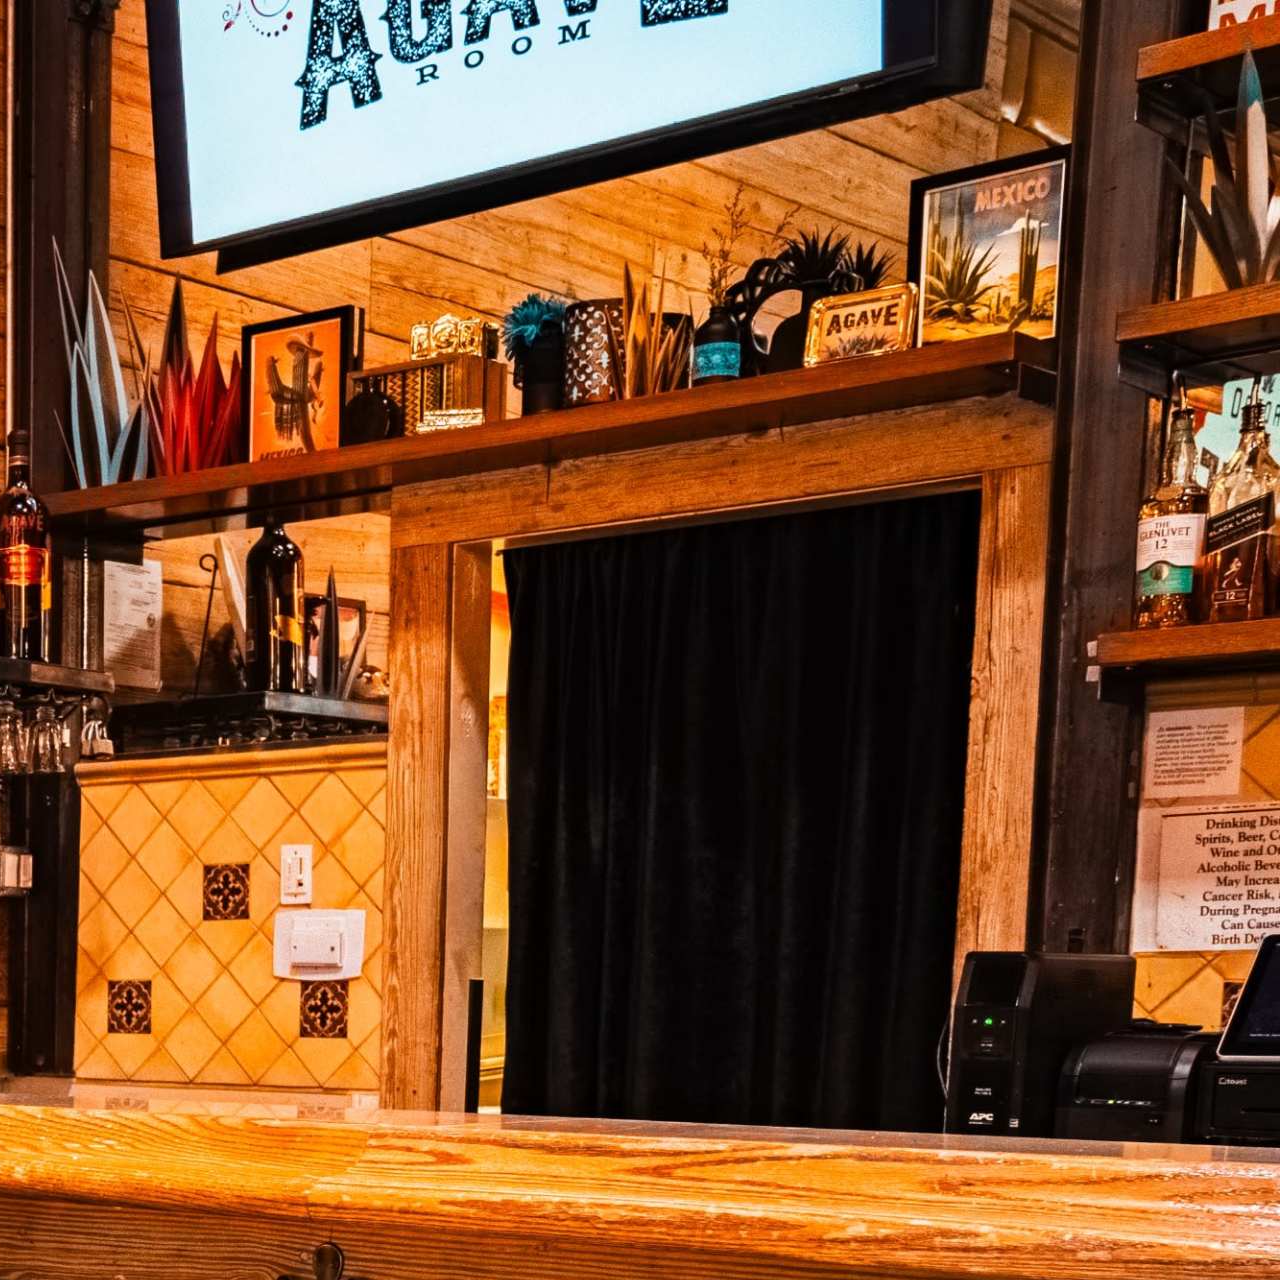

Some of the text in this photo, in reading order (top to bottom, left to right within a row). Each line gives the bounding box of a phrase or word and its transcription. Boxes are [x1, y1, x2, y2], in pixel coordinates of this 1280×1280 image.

[415, 19, 591, 86] ROOM
[974, 176, 1051, 213] MEXICO
[826, 302, 899, 336] AGAVE
[1155, 521, 1169, 529] THE
[1140, 526, 1191, 542] GLENLIVET
[1155, 538, 1168, 550] 12
[1225, 591, 1236, 601] 12
[1206, 816, 1257, 830] Drinking
[1195, 833, 1234, 847] Spirits,
[1238, 831, 1266, 843] Beer,
[1210, 847, 1240, 858] Wine
[1243, 845, 1263, 857] and
[1196, 861, 1251, 873] Alcoholic
[1216, 875, 1240, 889] May
[1202, 888, 1275, 902] Cancer Risk,
[1200, 905, 1240, 918] During
[1221, 918, 1280, 930] Can Cause
[1211, 933, 1241, 945] Birth
[969, 1112, 994, 1121] APC
